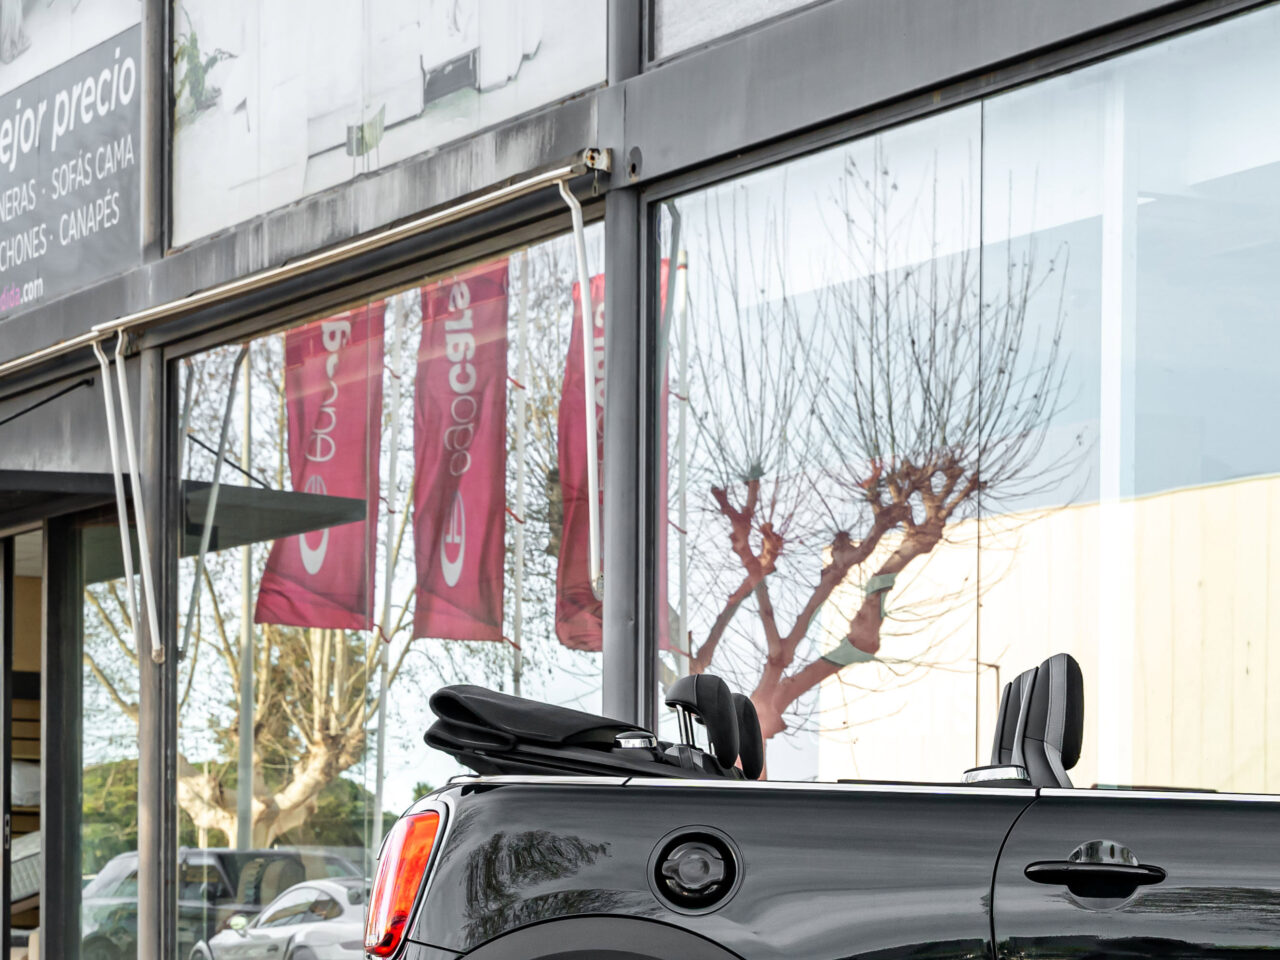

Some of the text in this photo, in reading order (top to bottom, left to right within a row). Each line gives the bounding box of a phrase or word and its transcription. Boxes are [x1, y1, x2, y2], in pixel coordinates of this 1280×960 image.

[51, 47, 136, 151] precio
[51, 150, 92, 200] SOFÁS
[95, 133, 135, 180] CAMA
[59, 187, 120, 247] CANAPÉS
